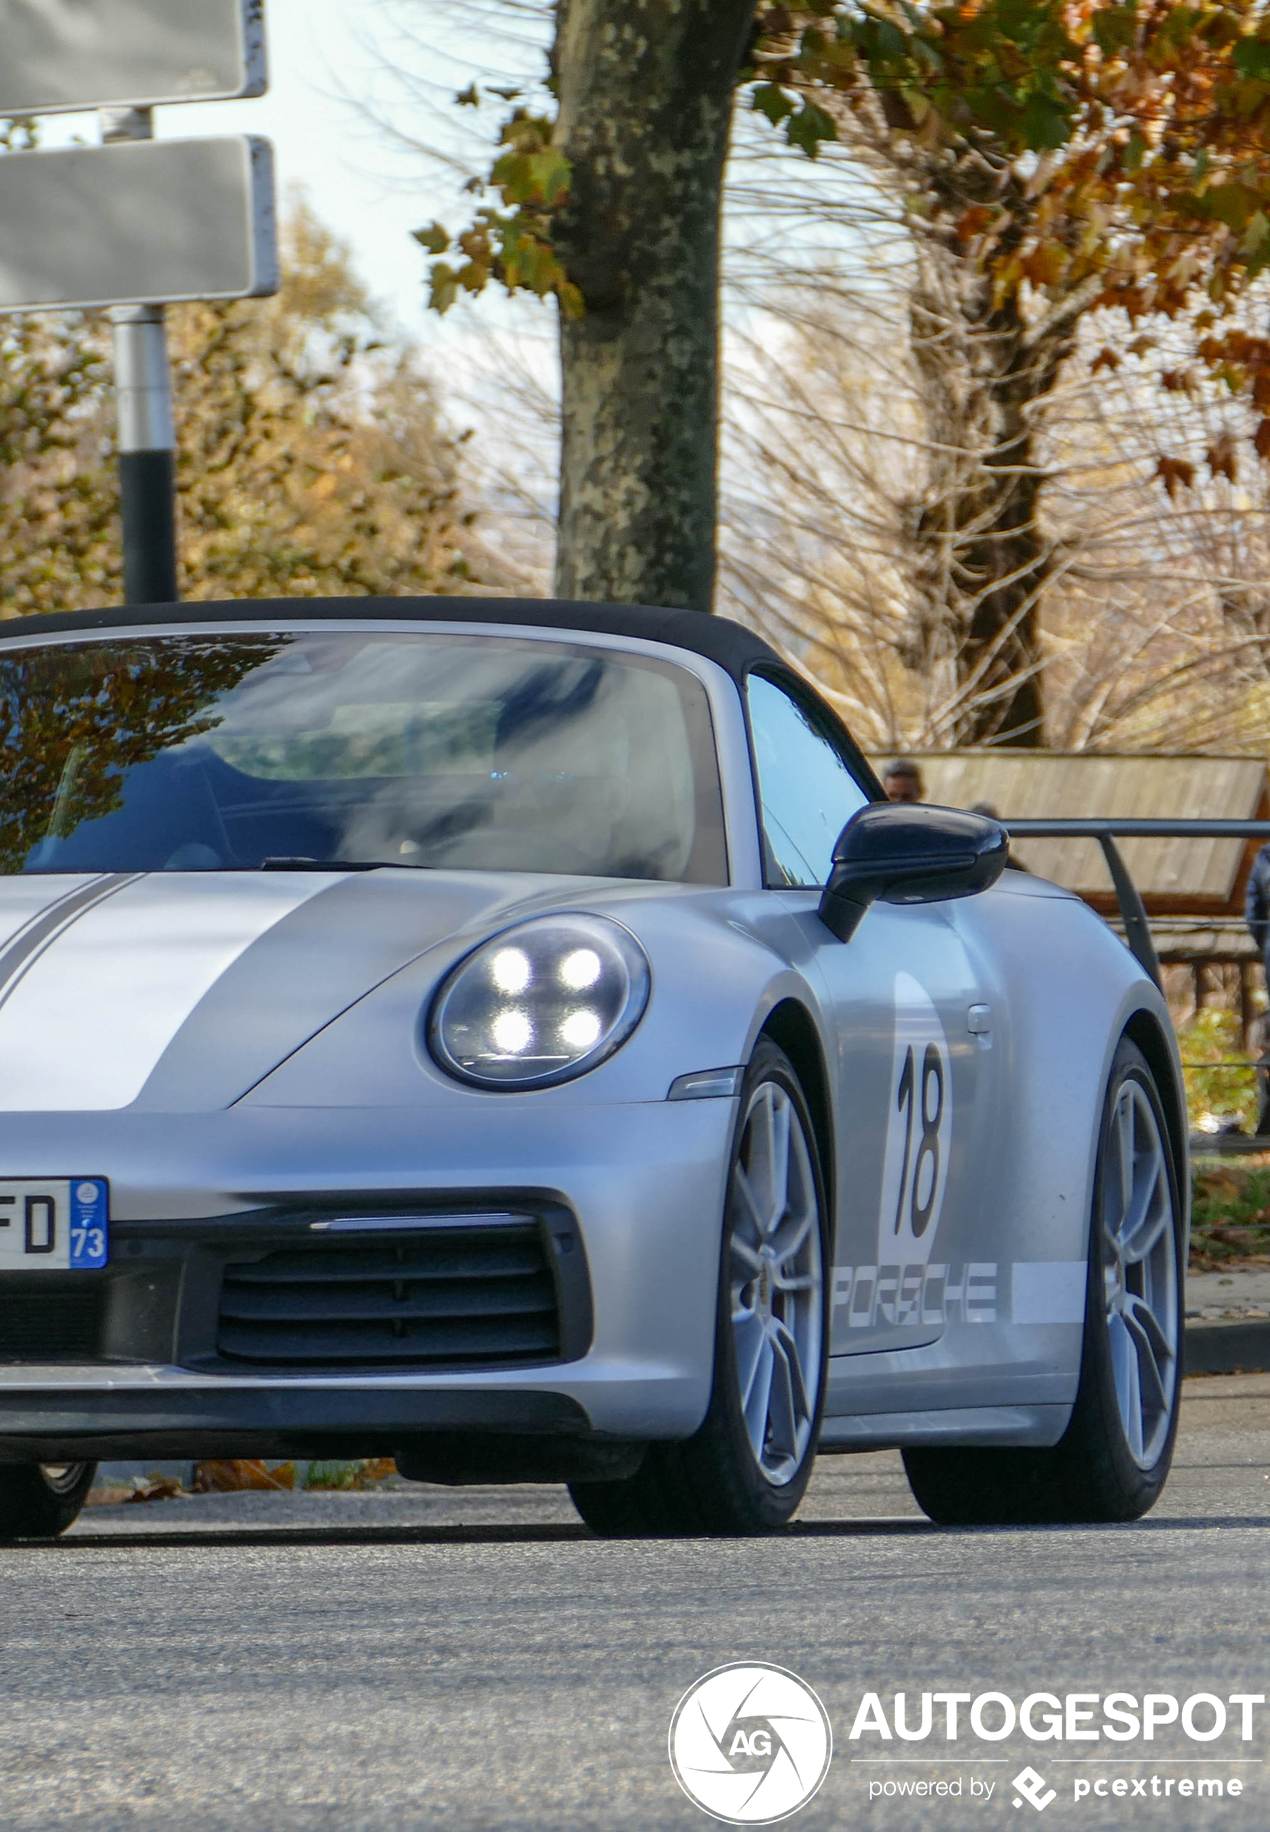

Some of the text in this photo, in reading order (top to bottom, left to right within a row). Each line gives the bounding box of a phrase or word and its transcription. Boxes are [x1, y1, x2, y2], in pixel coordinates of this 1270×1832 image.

[894, 1041, 944, 1238] 18
[71, 1227, 105, 1258] 73
[831, 1262, 998, 1328] PORSCHE
